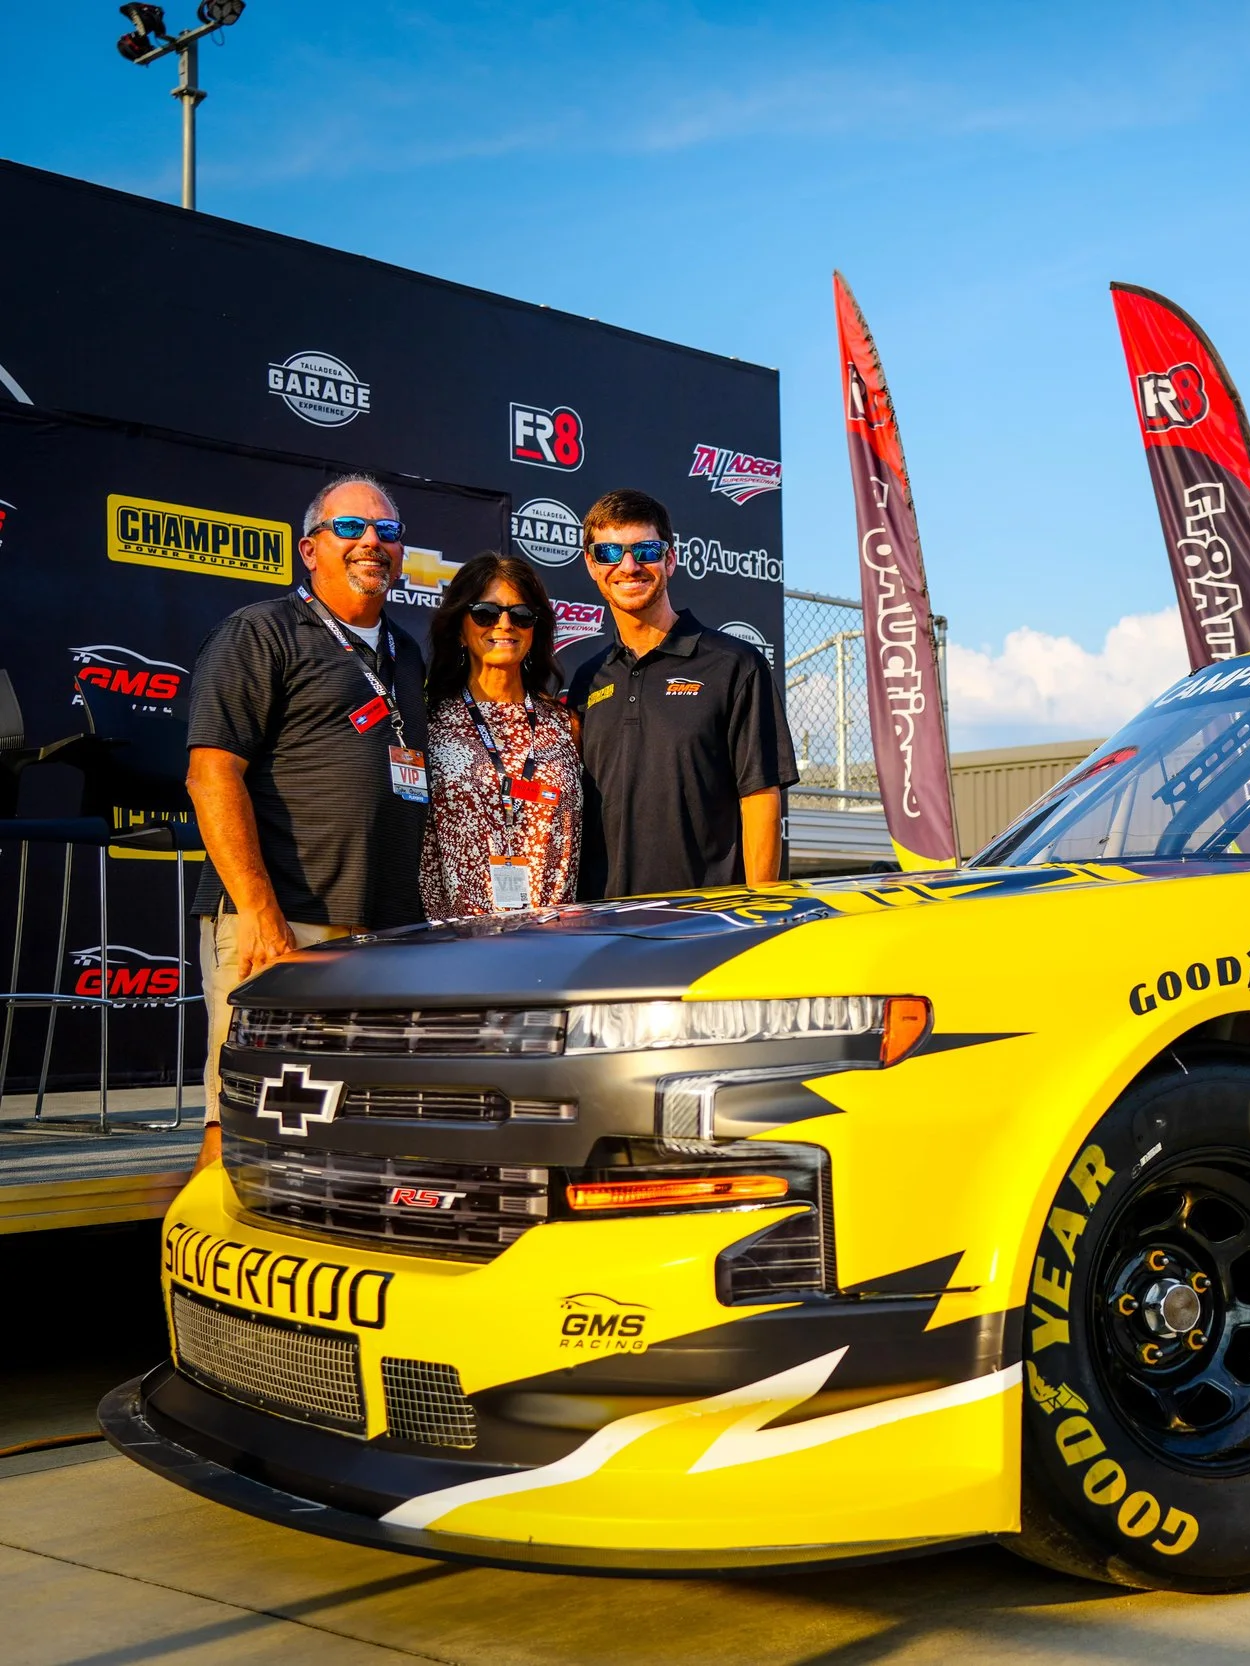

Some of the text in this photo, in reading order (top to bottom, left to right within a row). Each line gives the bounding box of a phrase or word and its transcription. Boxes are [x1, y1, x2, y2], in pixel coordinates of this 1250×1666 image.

[301, 362, 343, 377] TALLADEGA
[268, 368, 370, 408] GARAGE
[299, 401, 345, 417] EXPERIENCE
[515, 409, 580, 465] FR8
[690, 445, 782, 487] TALLADEGA
[532, 508, 568, 520] TALLADEGA
[120, 509, 281, 563] CHAMPION
[124, 544, 280, 573] POWER EQUIPMENT
[530, 544, 569, 557] EXPERIENCE
[666, 683, 701, 692] GMS
[400, 767, 420, 785] VIP
[75, 968, 180, 996] GMS
[390, 1187, 467, 1209] RST
[166, 1222, 395, 1330] SILVERADO
[562, 1314, 646, 1336] GMS
[559, 1339, 644, 1349] RACING
